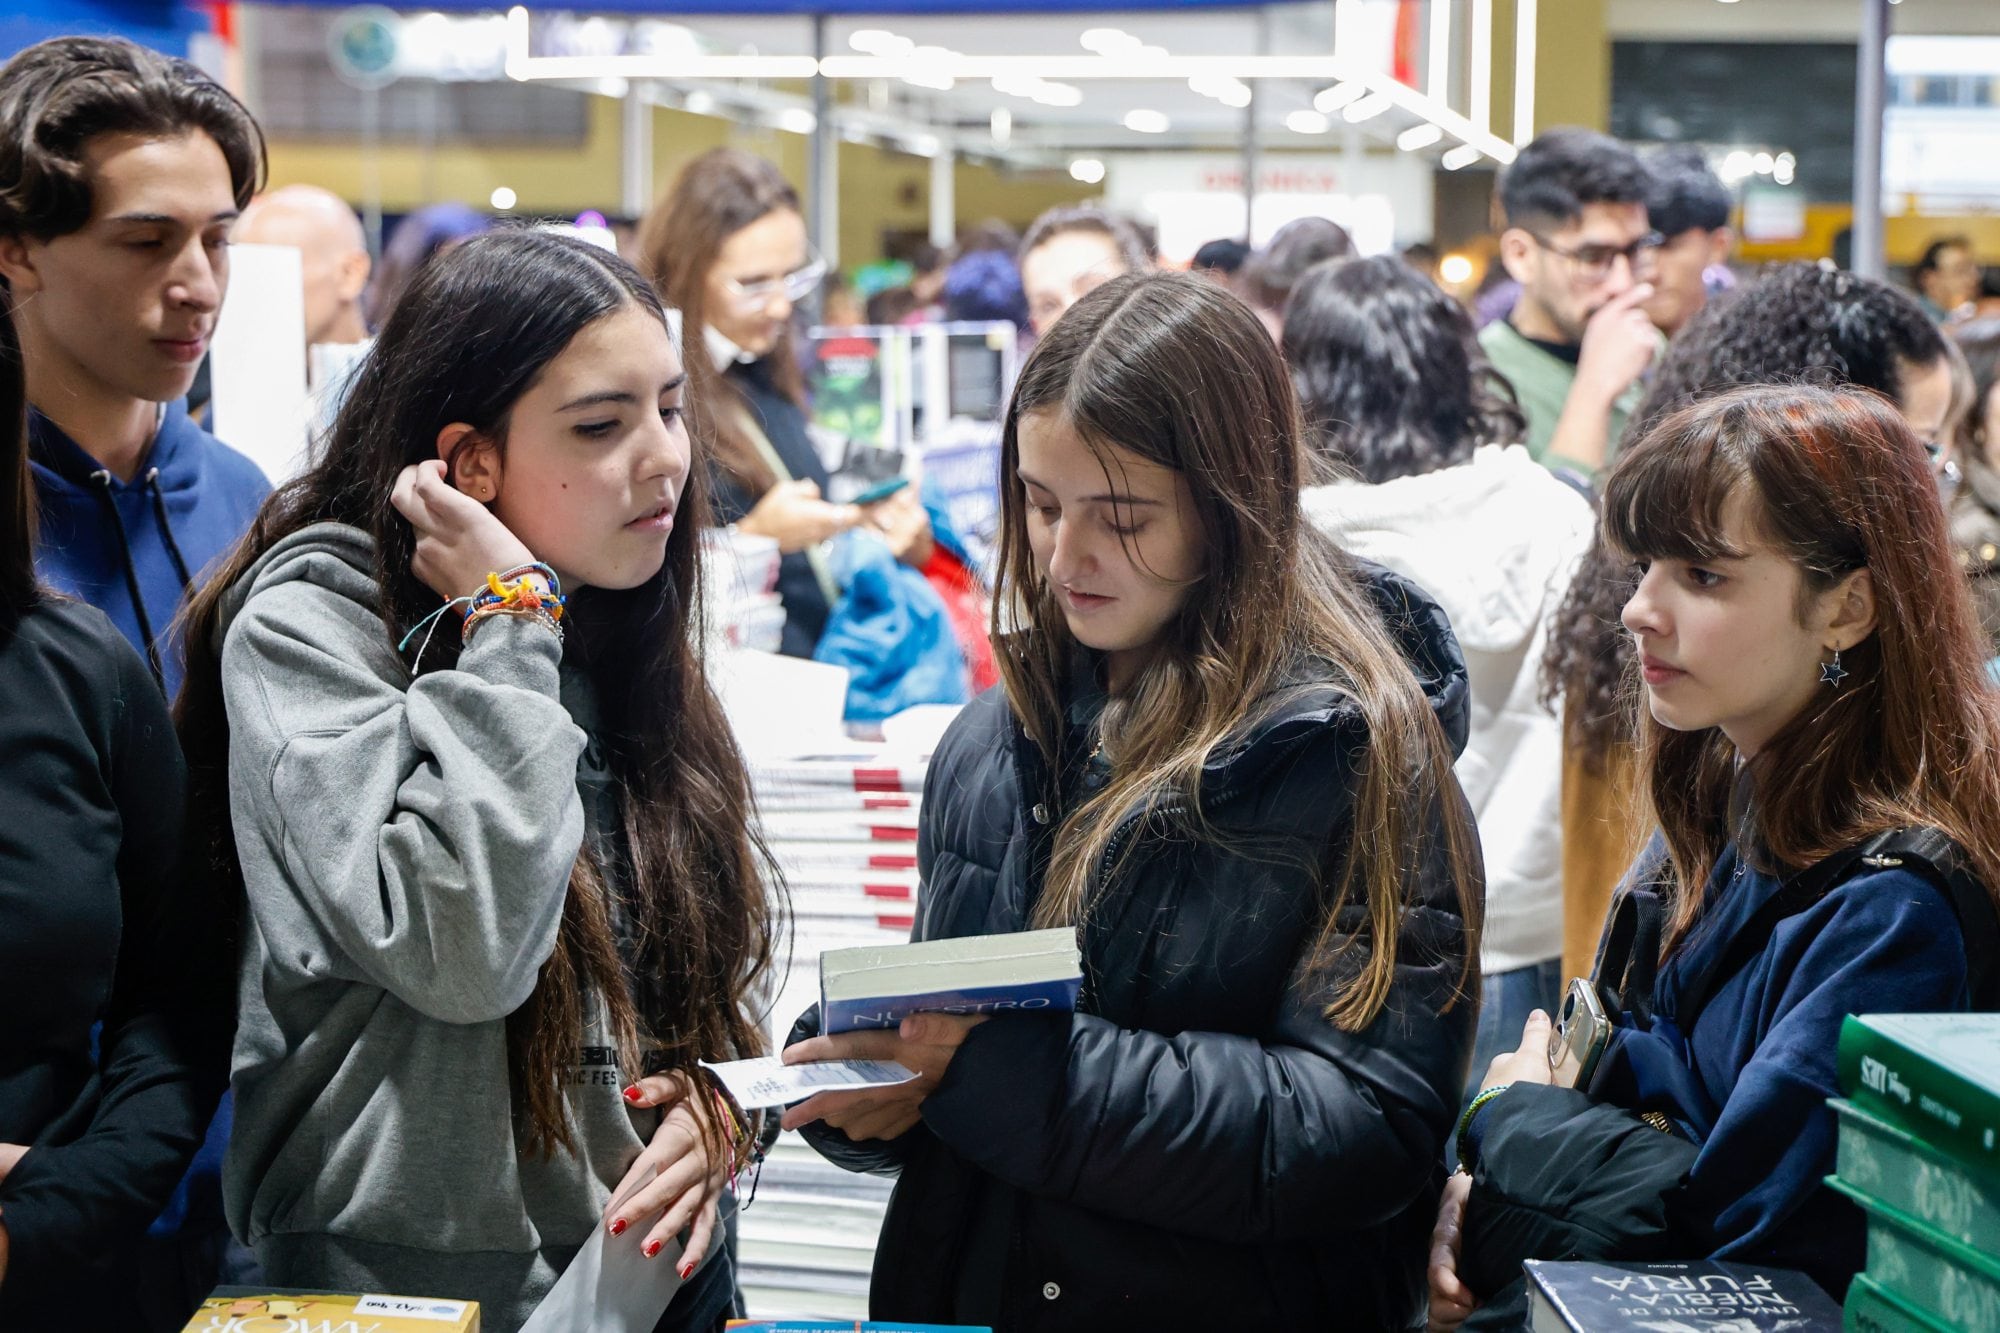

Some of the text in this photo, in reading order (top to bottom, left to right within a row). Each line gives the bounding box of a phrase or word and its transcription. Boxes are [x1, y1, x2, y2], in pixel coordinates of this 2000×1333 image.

[1591, 1274, 1773, 1292] FURIA
[1628, 1292, 1794, 1307] NIEBLA
[1617, 1305, 1800, 1316] UNA CORTE DE
